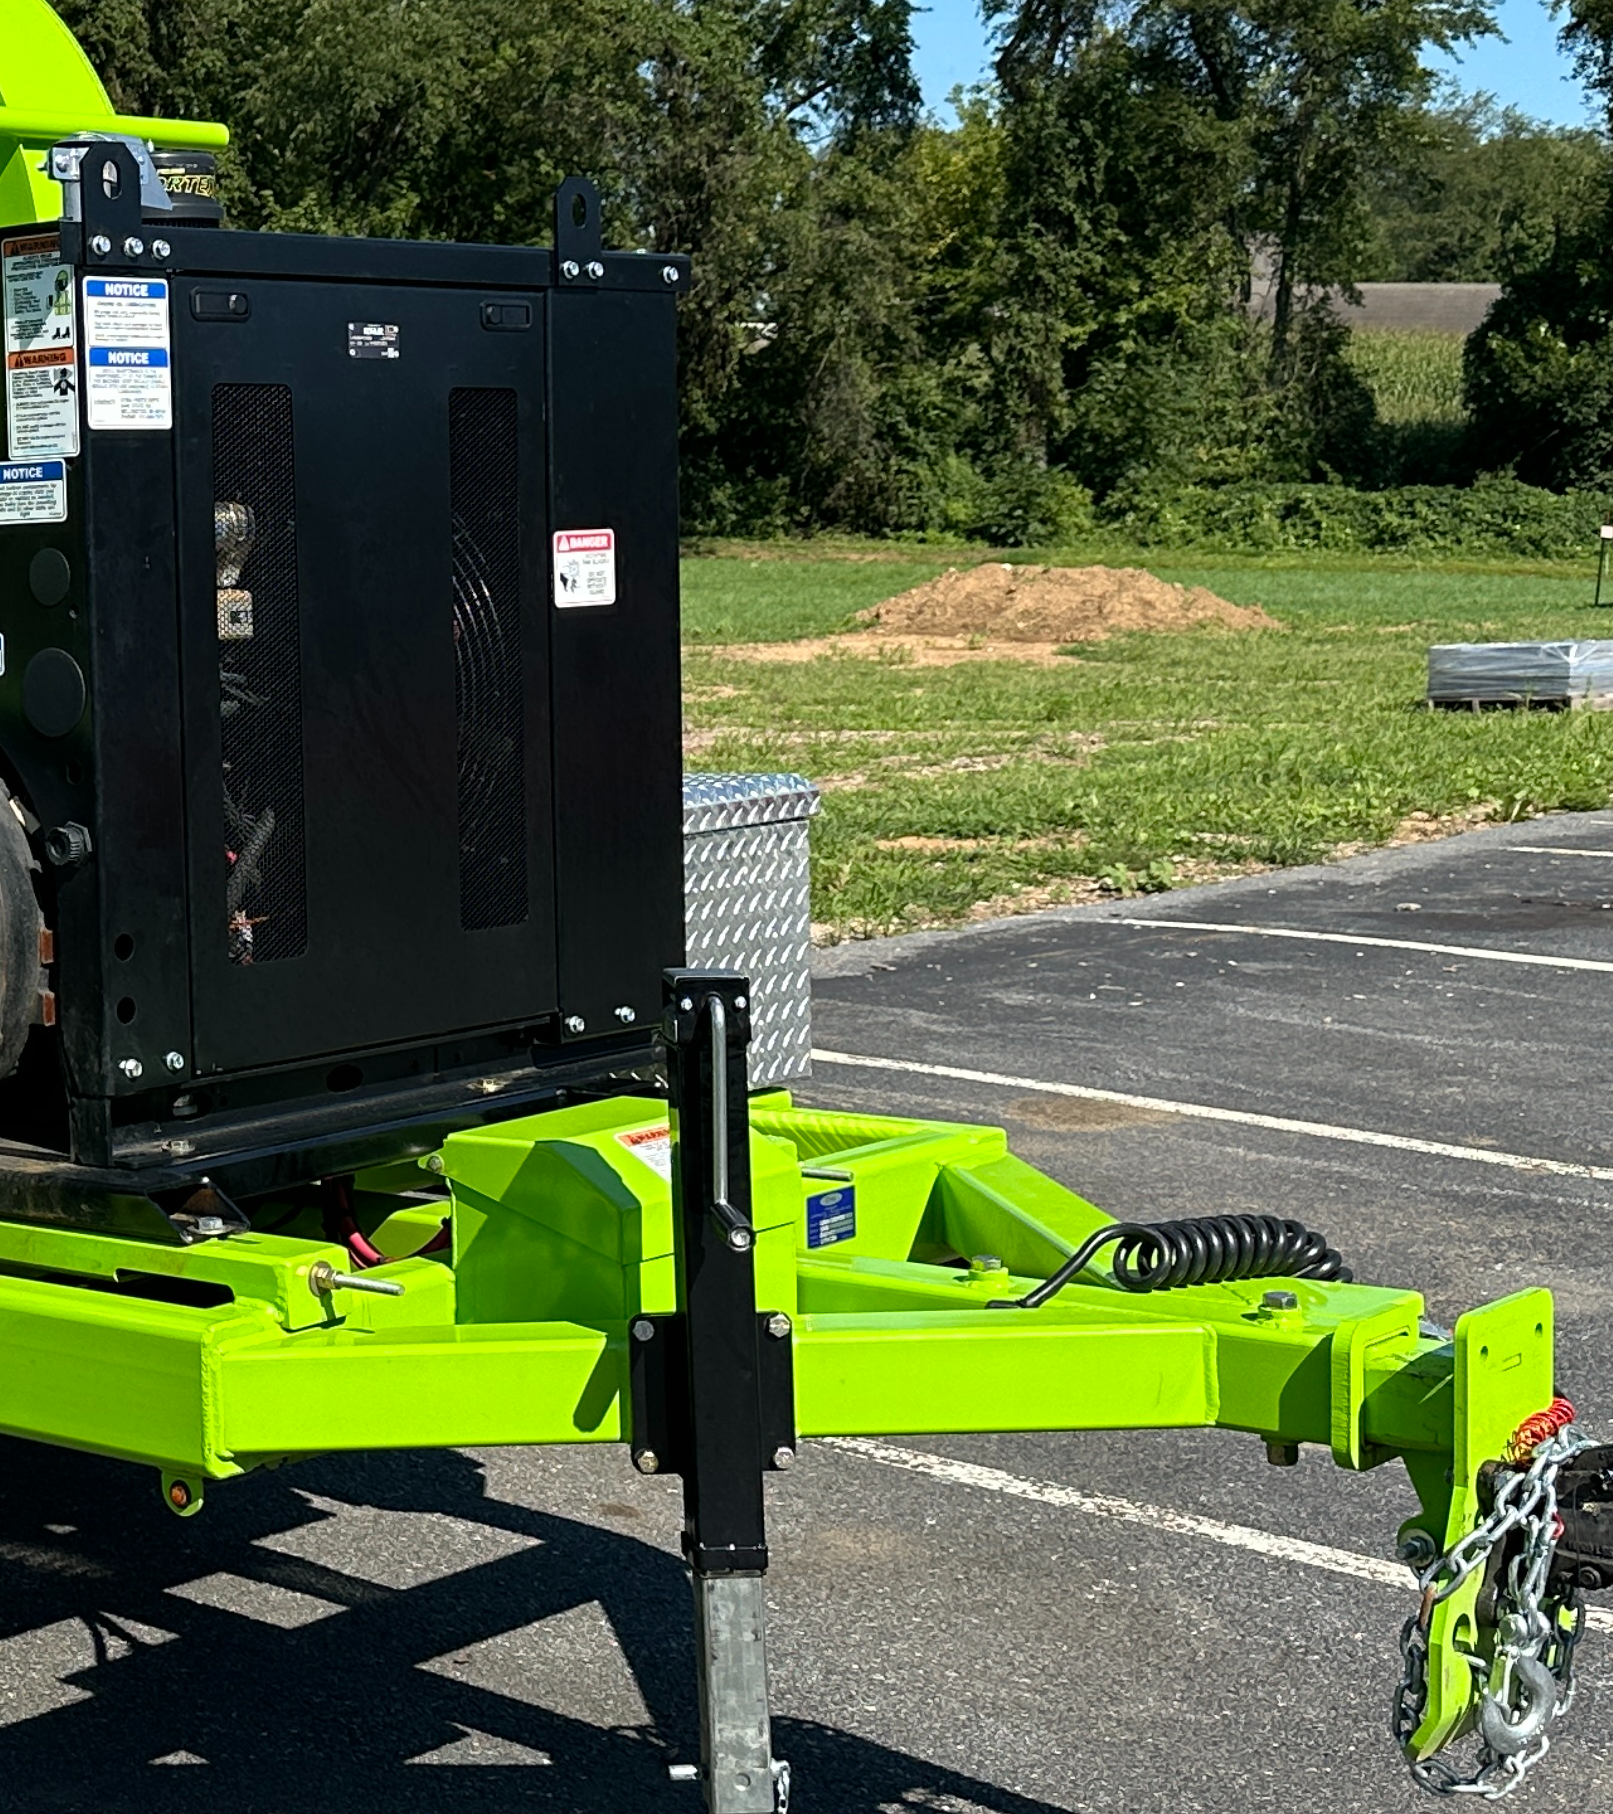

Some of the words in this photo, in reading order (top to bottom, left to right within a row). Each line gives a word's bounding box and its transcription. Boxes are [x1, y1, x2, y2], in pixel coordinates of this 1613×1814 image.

[104, 283, 149, 297] NOTICE
[23, 352, 67, 366] WARNING
[107, 351, 150, 365] NOTICE
[2, 466, 44, 480] NOTICE
[569, 536, 609, 549] DANGER
